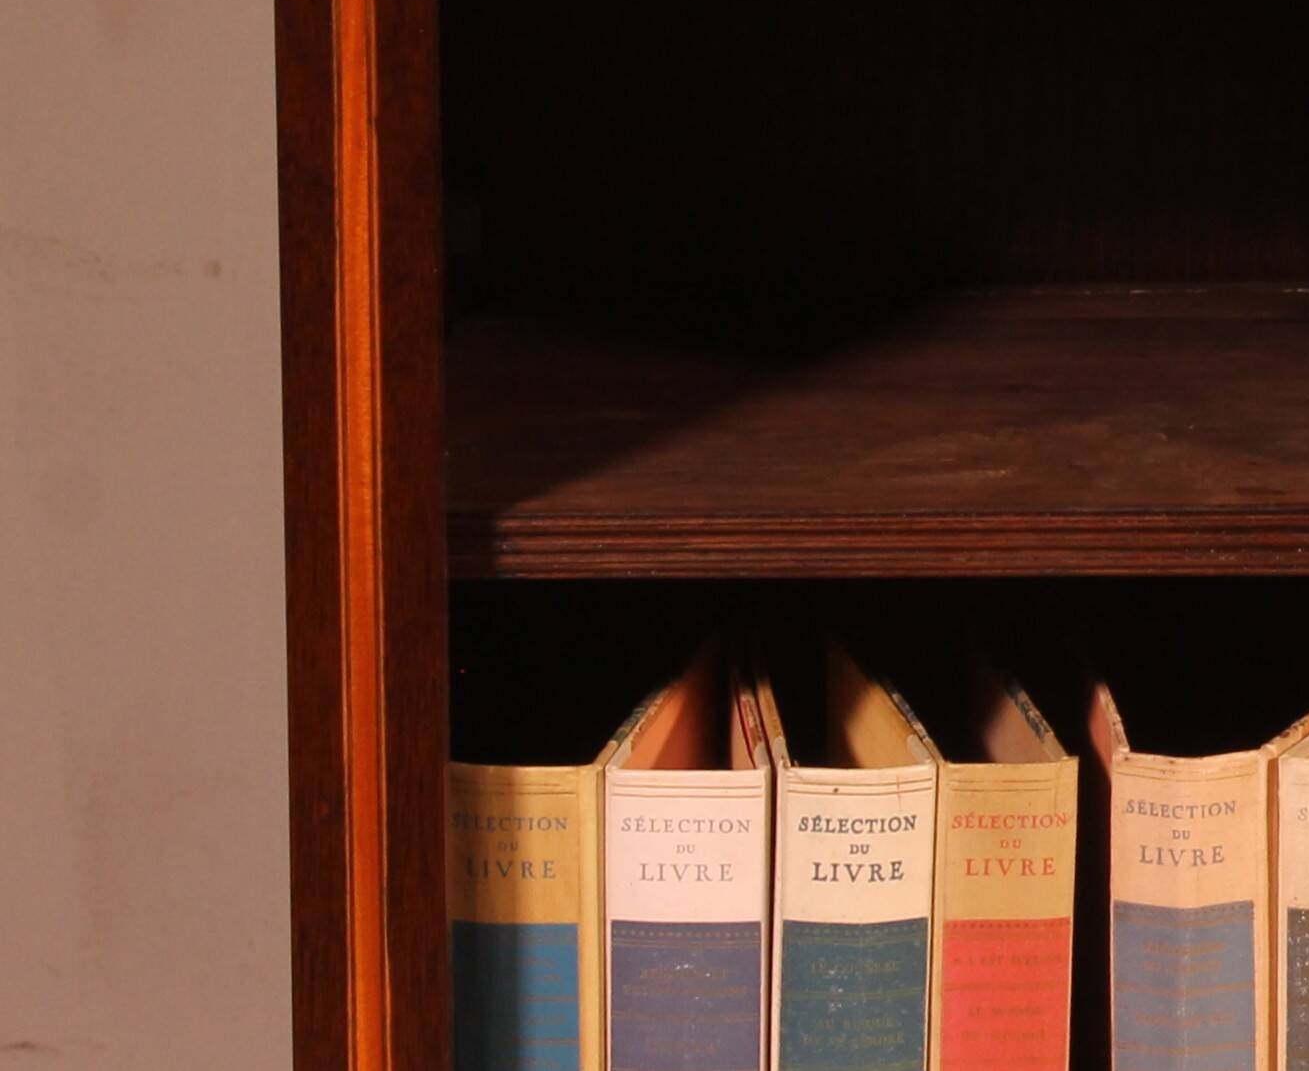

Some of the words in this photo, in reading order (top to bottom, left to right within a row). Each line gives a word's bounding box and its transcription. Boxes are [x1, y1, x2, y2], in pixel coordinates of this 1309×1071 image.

[1126, 799, 1236, 819] SÉLECTION
[622, 814, 752, 834] SÉLECTION
[798, 814, 917, 835] SÉLECTION
[952, 811, 1068, 829] SÉLECTION
[1000, 838, 1022, 849] DU
[1172, 830, 1191, 840] DU
[498, 840, 519, 852] DU
[676, 842, 696, 855] DU
[849, 842, 870, 855] DU
[1138, 845, 1225, 866] LIVRE
[465, 857, 556, 879] LIVRE
[639, 863, 734, 882] LIVRE
[811, 860, 905, 883] LIVRE
[964, 857, 1056, 878] LIVRE
